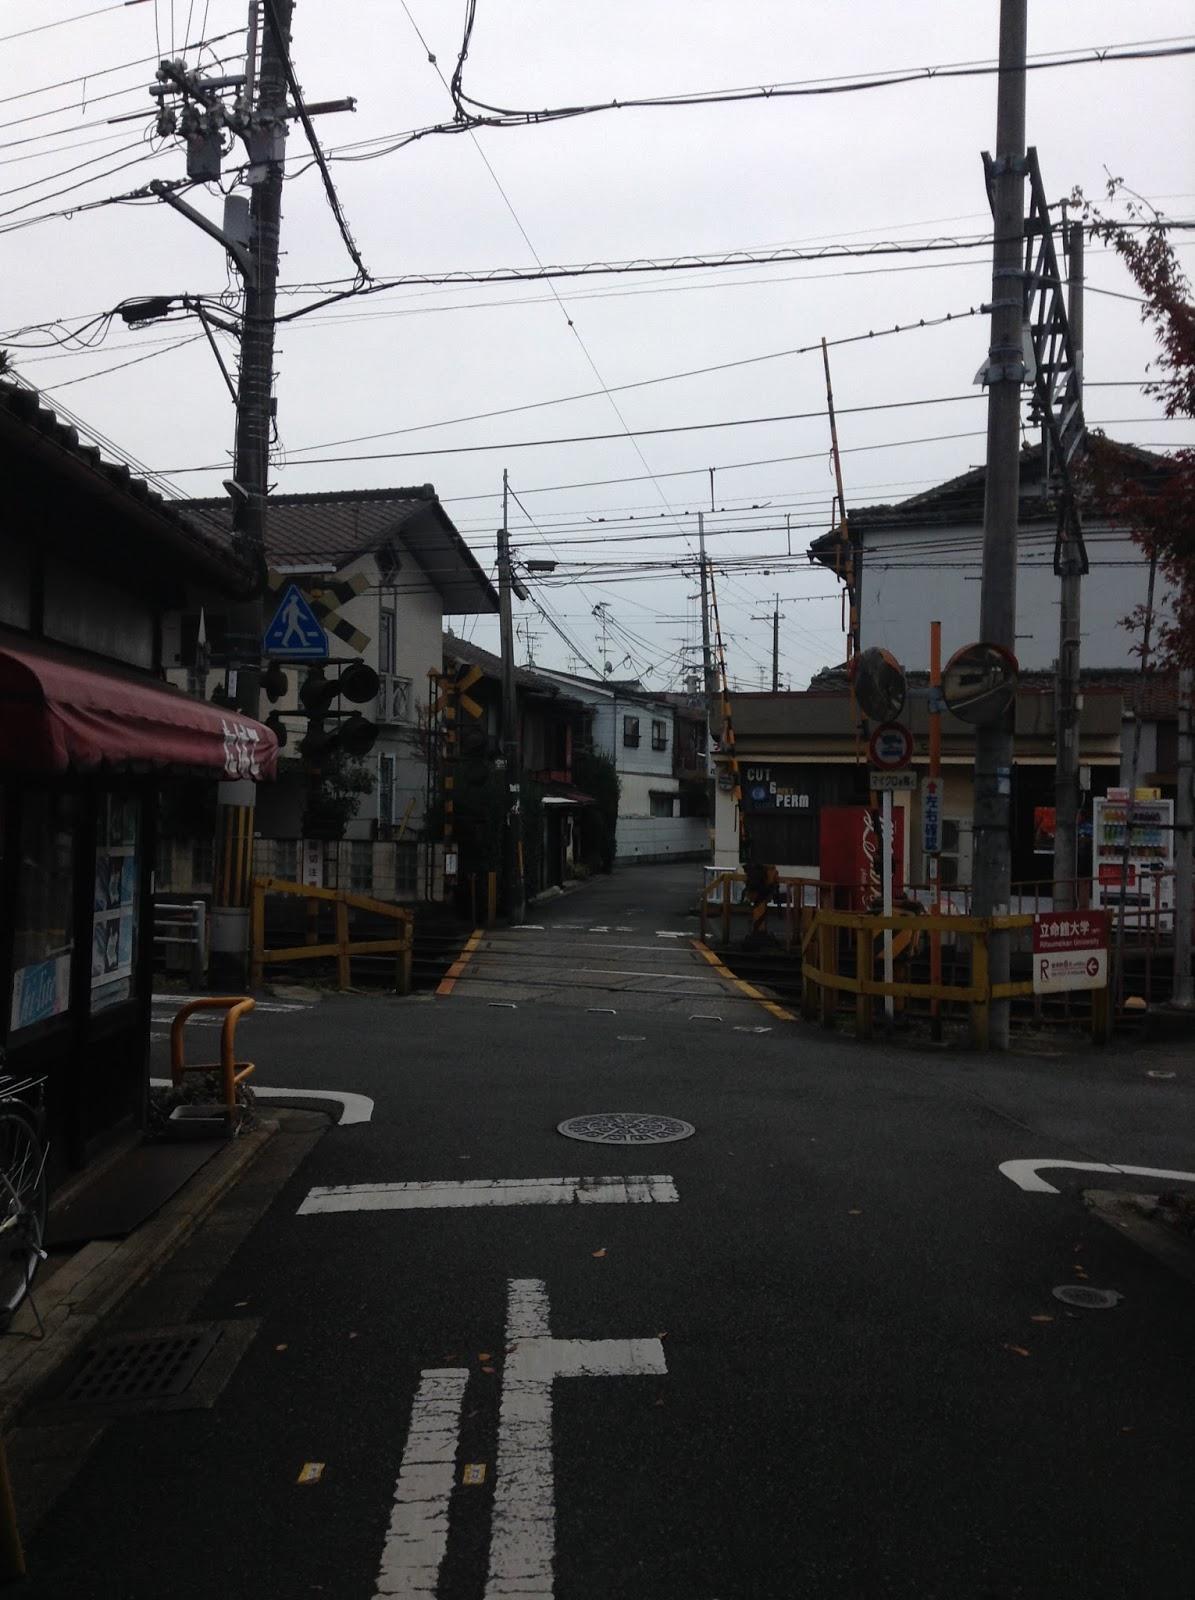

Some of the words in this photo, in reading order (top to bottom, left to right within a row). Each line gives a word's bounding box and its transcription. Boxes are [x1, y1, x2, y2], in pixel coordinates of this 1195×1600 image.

[746, 768, 772, 782] CUT
[775, 794, 809, 808] PERM
[925, 794, 938, 851] 左右確認
[1039, 919, 1090, 938] 立命館大学
[1073, 937, 1100, 947] University
